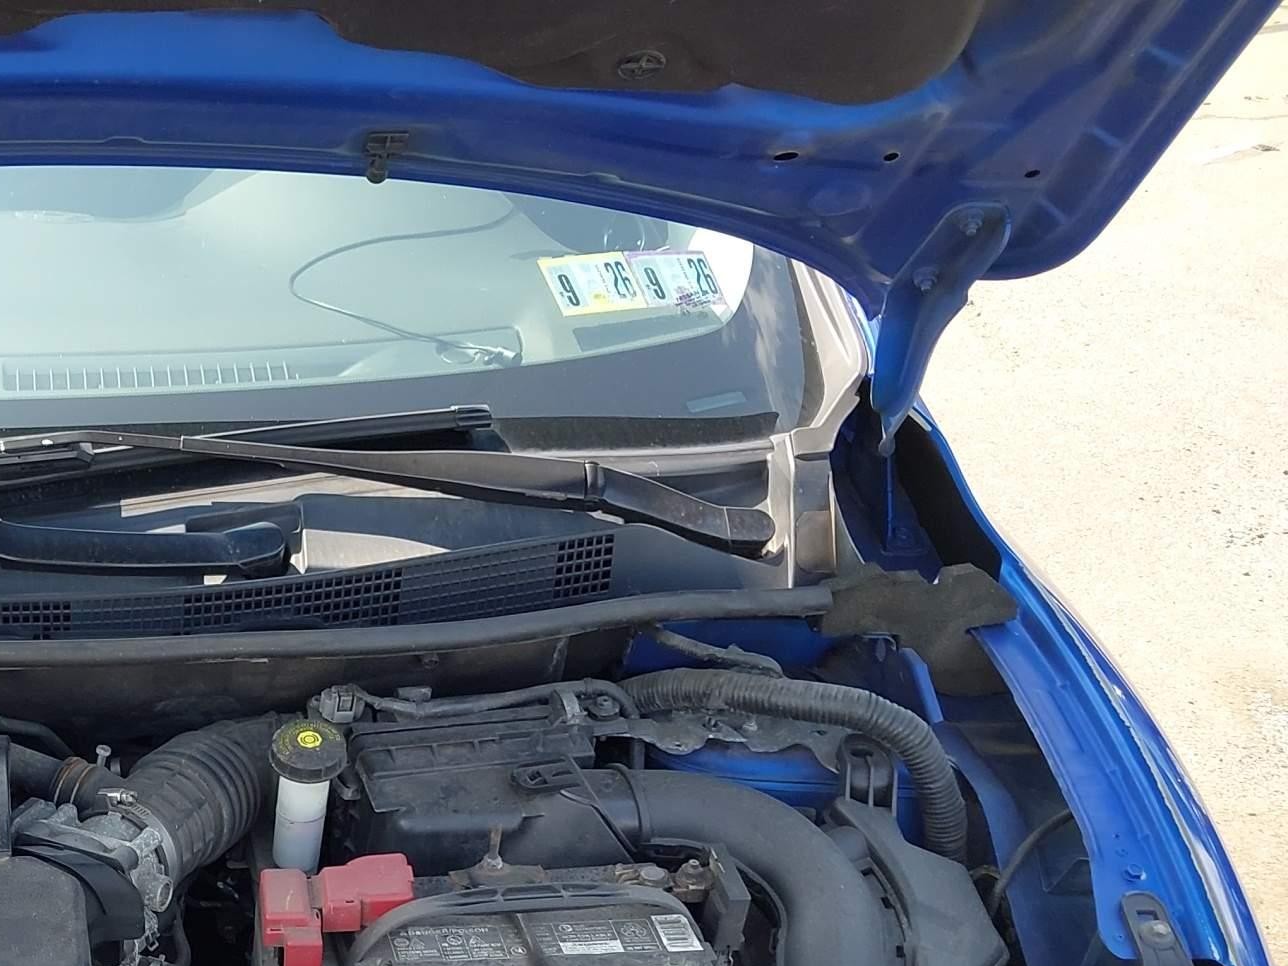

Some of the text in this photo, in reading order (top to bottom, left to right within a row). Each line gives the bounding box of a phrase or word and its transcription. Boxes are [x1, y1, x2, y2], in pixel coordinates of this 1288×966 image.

[558, 274, 580, 306] 9
[604, 261, 637, 298] 26
[644, 267, 666, 300] 9
[687, 258, 719, 297] 26
